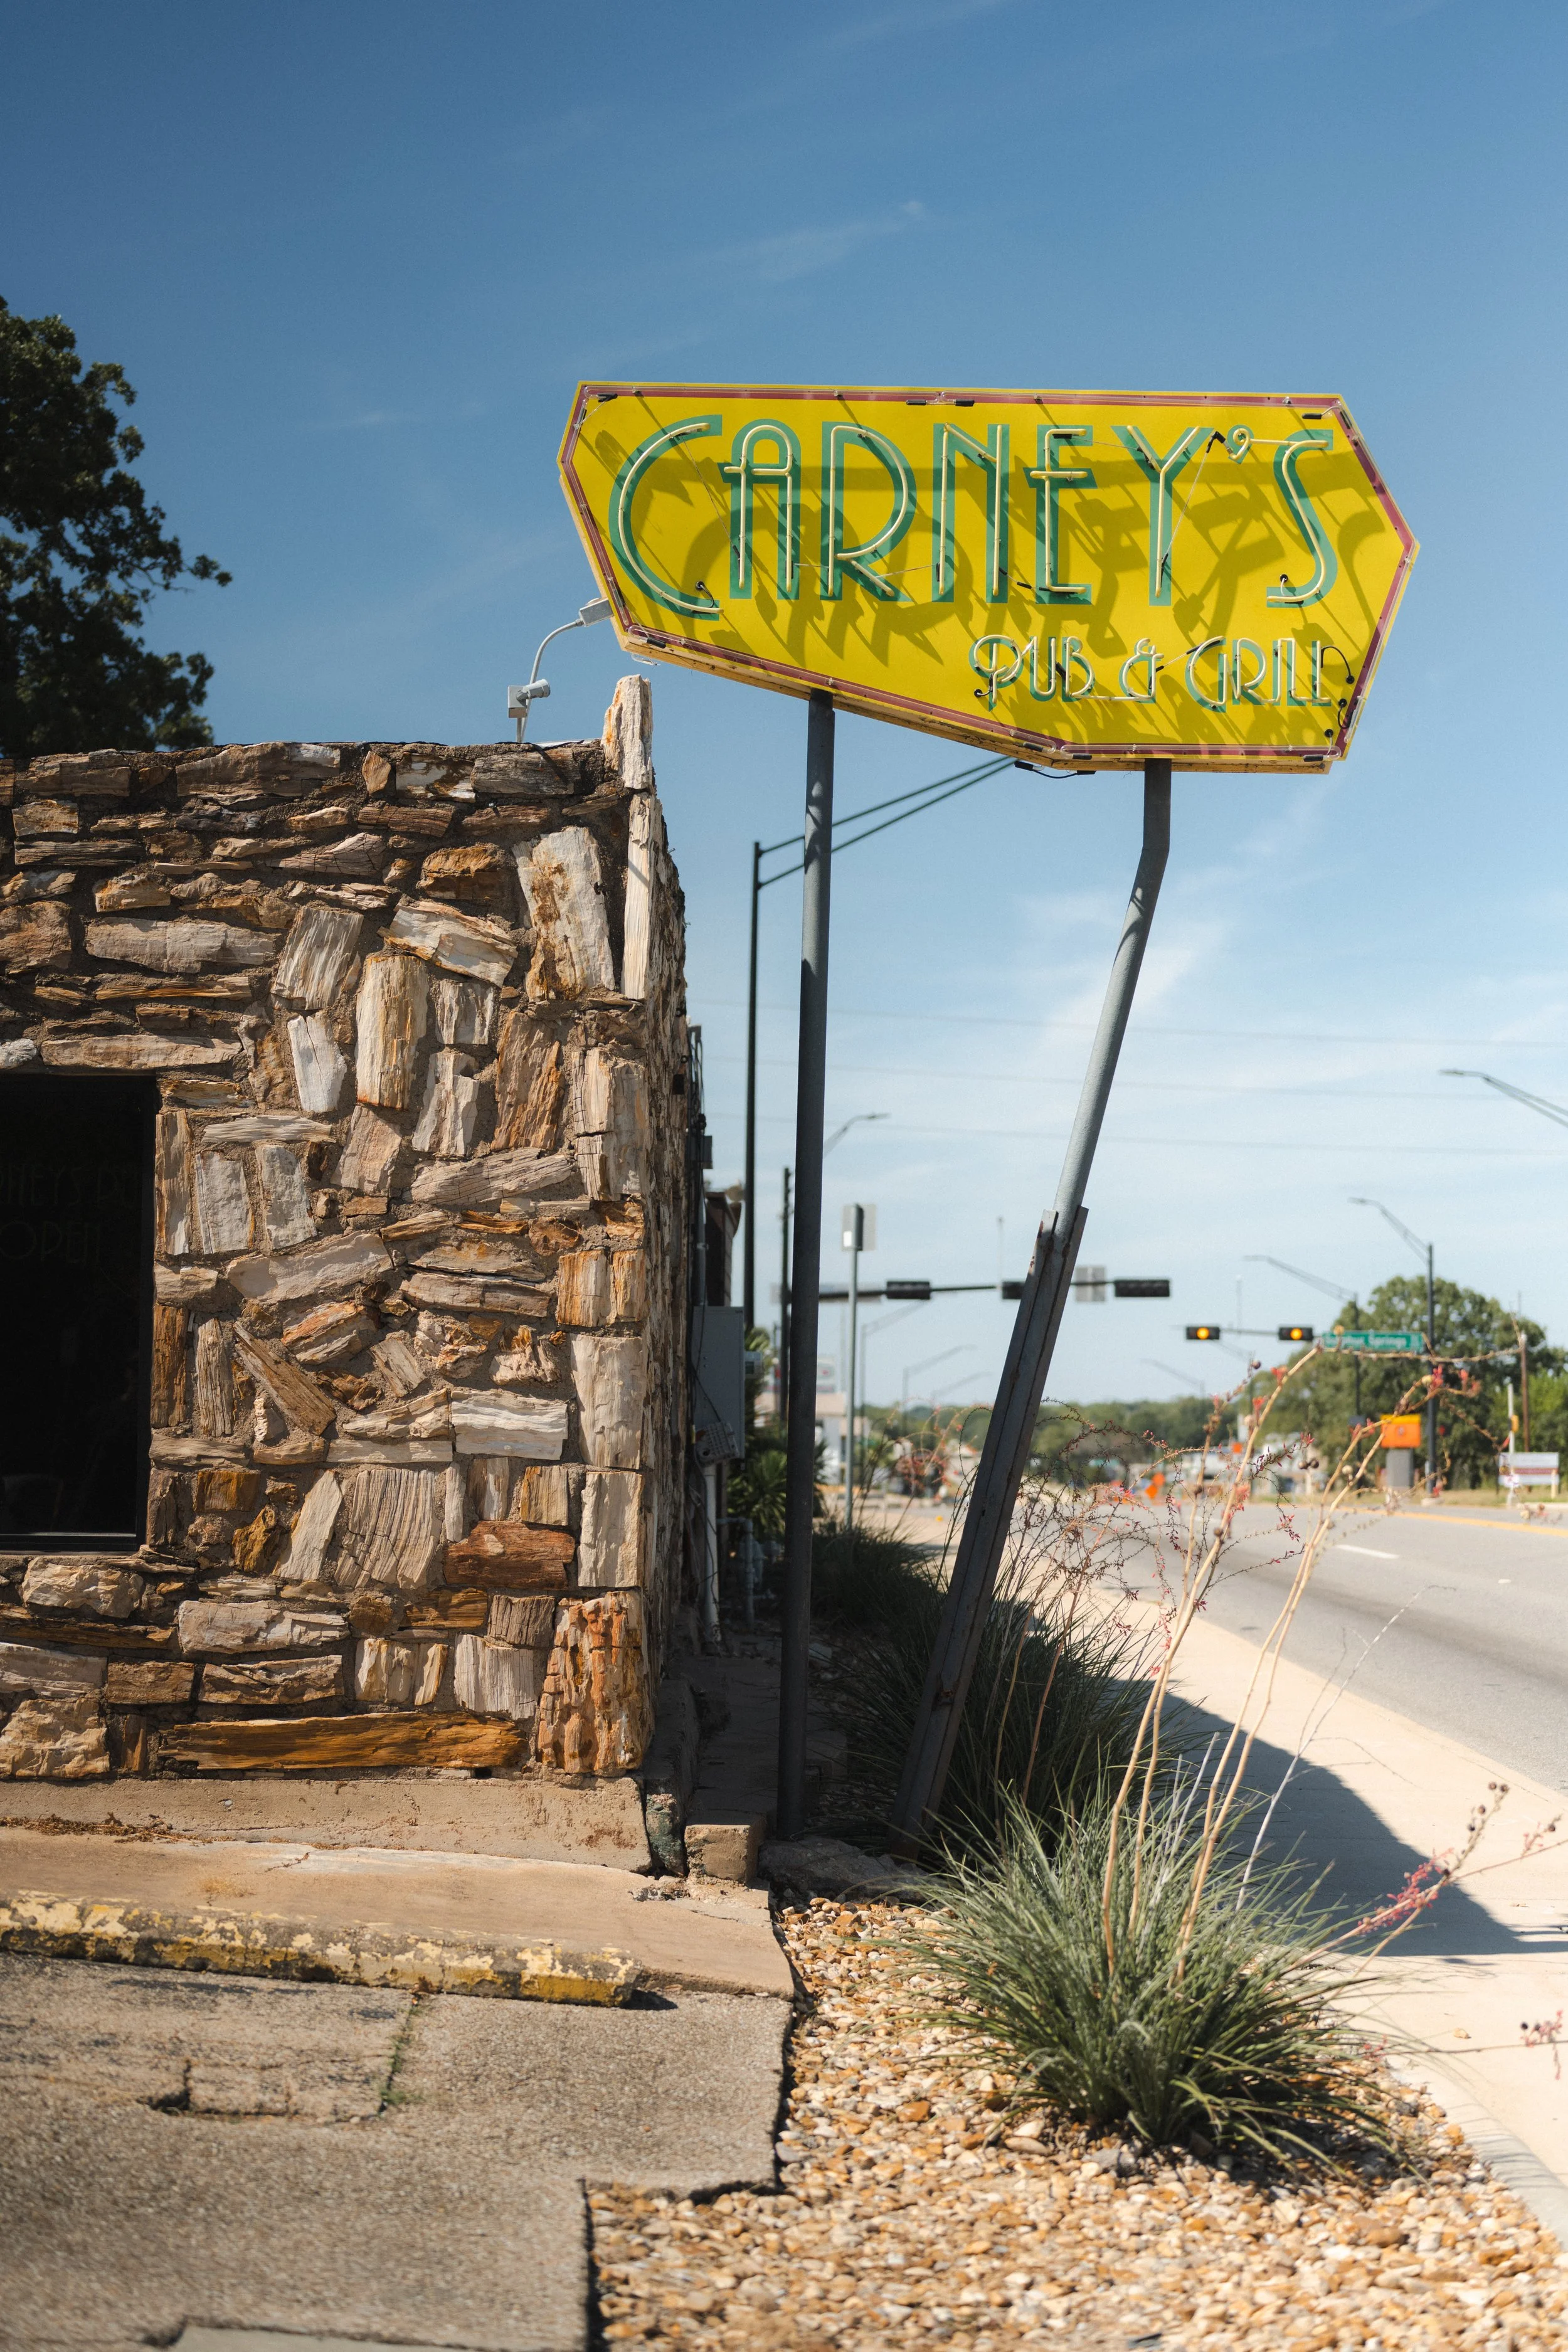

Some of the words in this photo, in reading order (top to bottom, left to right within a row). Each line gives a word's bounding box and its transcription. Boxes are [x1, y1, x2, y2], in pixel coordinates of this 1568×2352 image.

[608, 415, 1338, 621] CARNEY'S
[968, 635, 1097, 712] PUB
[1119, 637, 1165, 704] &
[1185, 635, 1332, 713] GRILL
